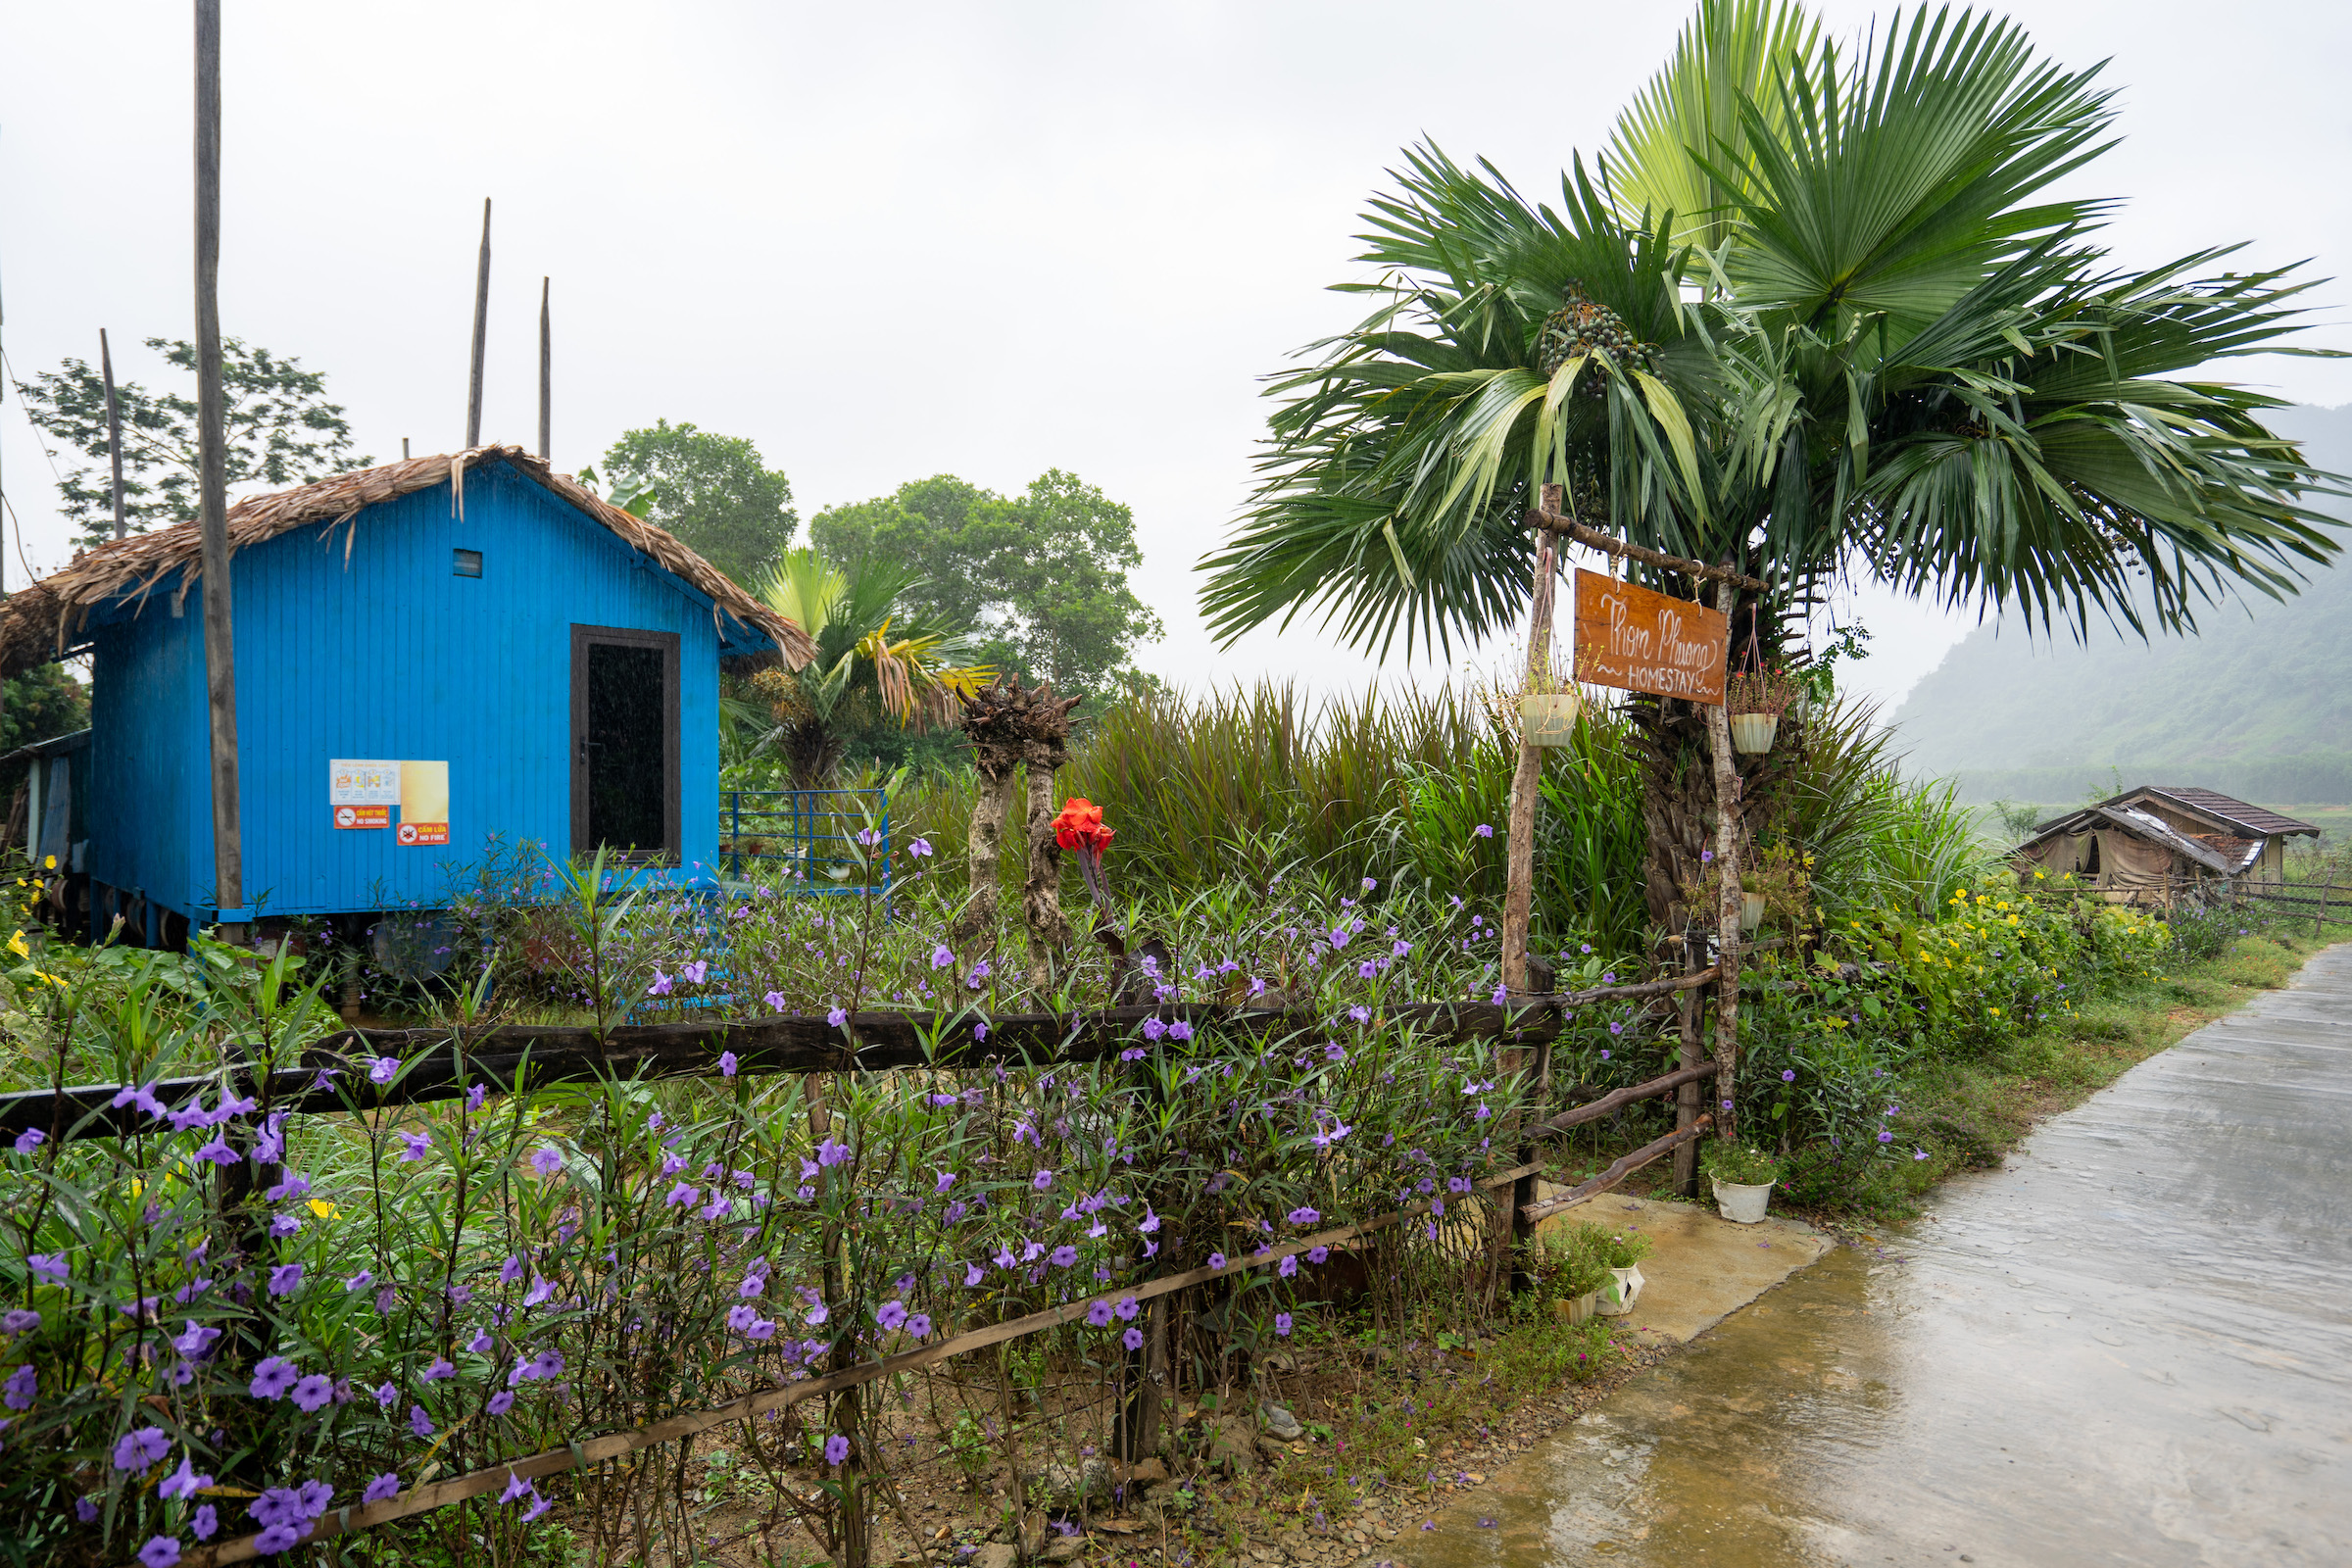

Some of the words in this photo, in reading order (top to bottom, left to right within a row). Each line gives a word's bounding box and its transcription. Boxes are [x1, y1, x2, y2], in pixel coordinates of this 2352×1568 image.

[1628, 664, 1695, 696] HOMESTAY
[417, 824, 433, 833] CẤM
[433, 824, 447, 833] LỬA
